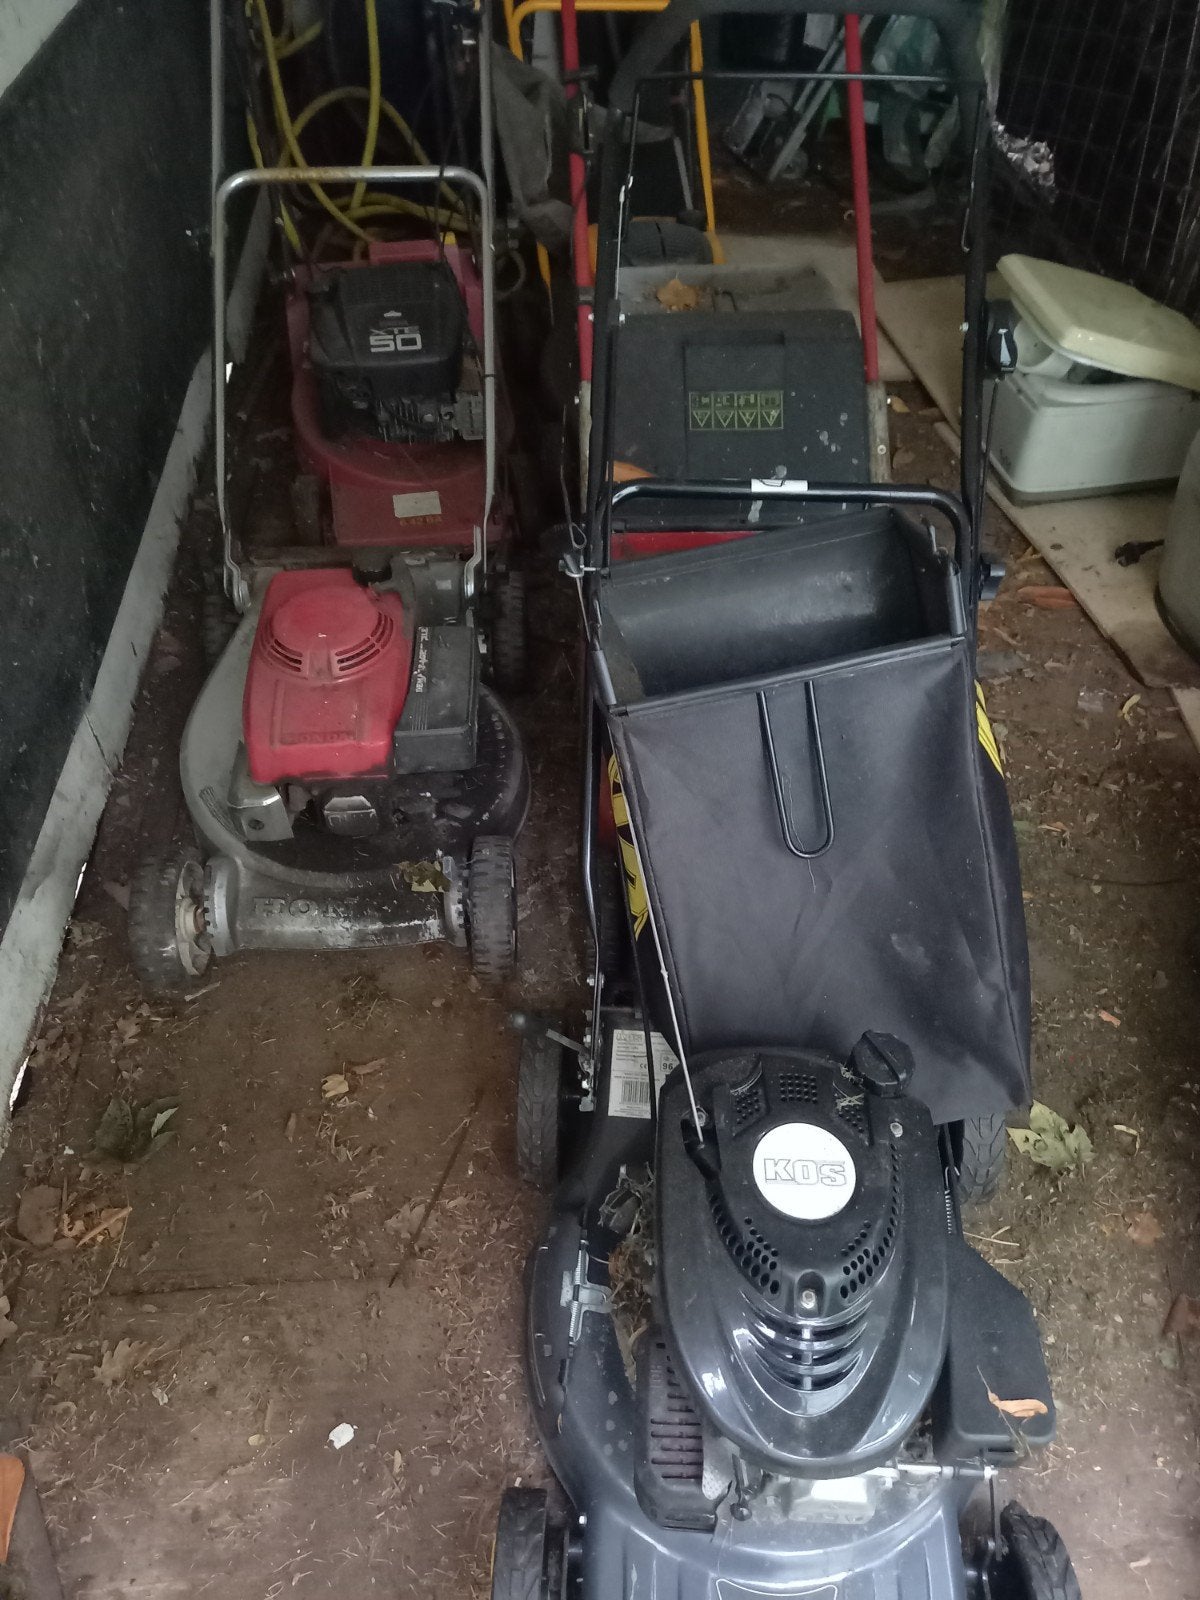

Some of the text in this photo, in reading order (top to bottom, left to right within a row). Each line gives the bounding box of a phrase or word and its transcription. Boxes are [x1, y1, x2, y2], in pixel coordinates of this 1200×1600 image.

[369, 333, 422, 353] 50
[281, 732, 354, 744] ONDA
[662, 1062, 673, 1070] 96
[763, 1158, 847, 1187] KOS
